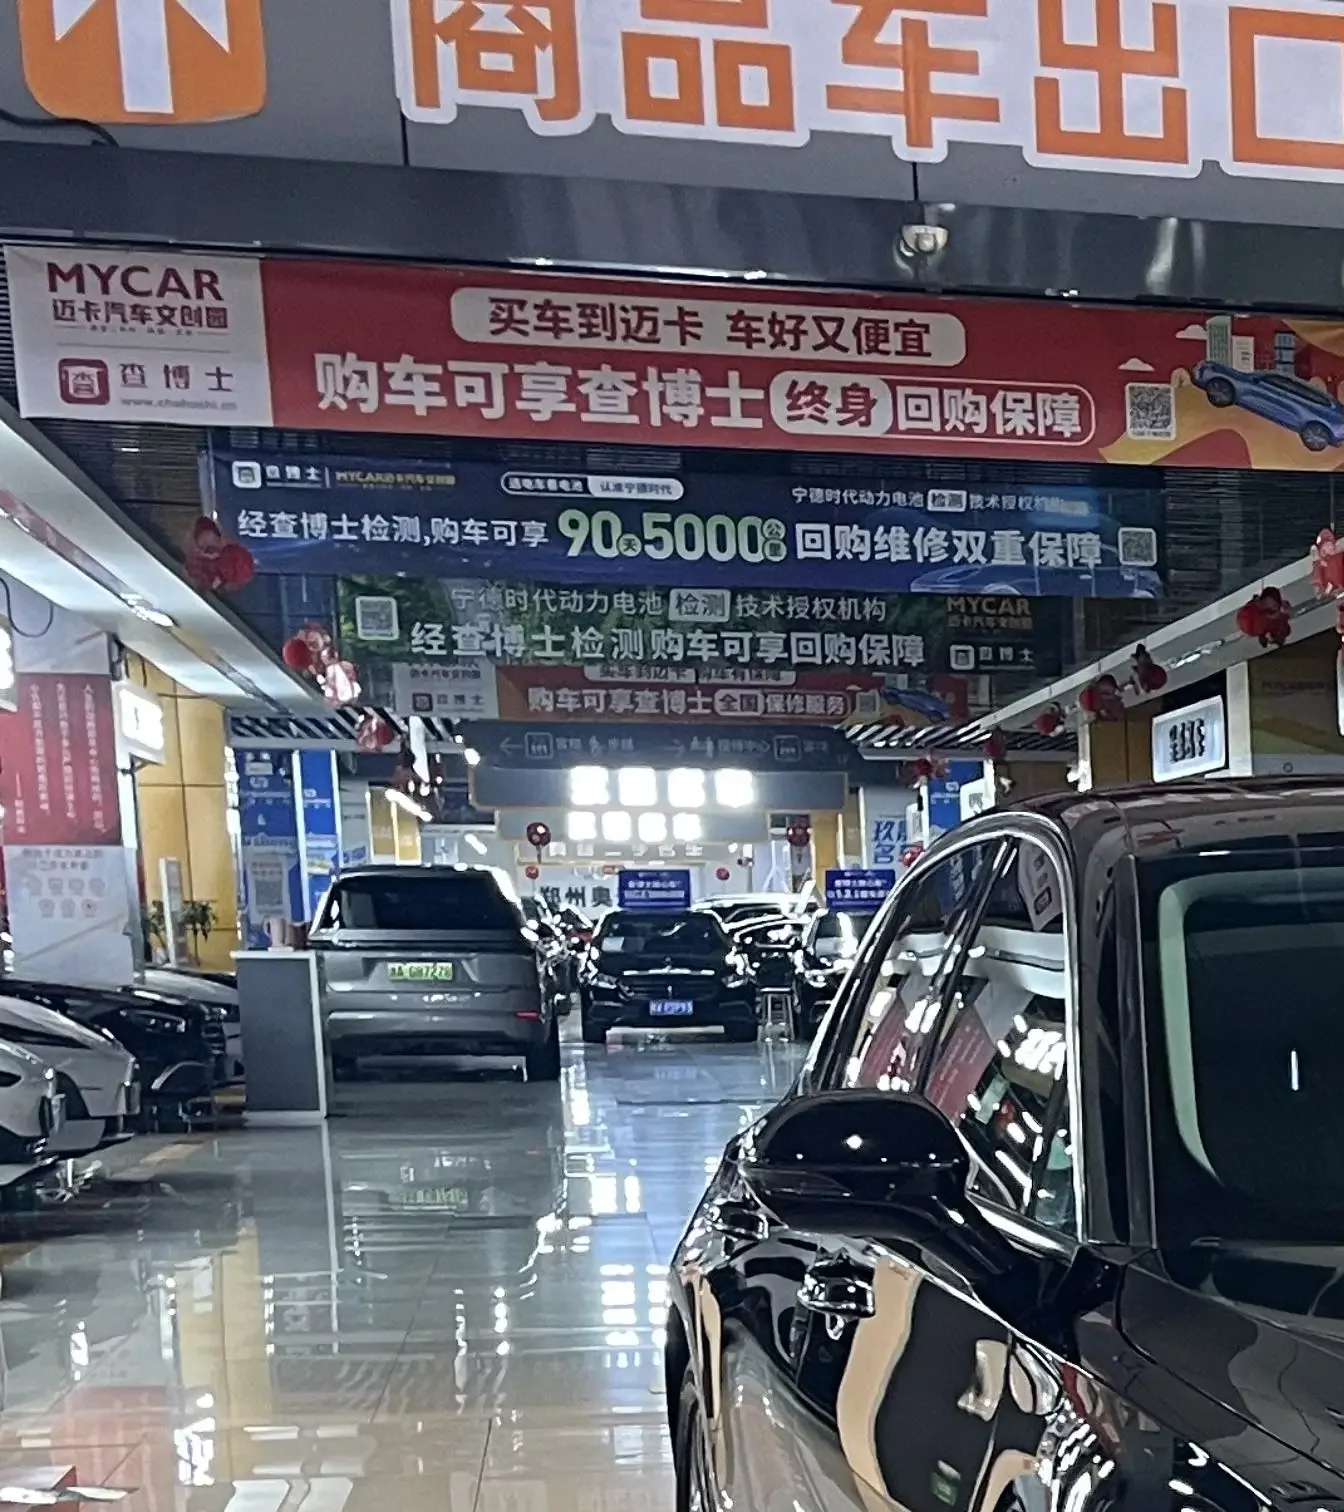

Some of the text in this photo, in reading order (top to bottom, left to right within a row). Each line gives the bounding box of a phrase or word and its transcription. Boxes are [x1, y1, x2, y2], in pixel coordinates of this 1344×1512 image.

[47, 262, 225, 301] MYCAR
[52, 299, 229, 329] 迈卡汽车文创园
[487, 296, 933, 359] 买车到迈卡 车好又便宜
[118, 362, 234, 393] 查博士
[315, 352, 1084, 441] 购车可享查博士终身回购保障
[794, 522, 1102, 568] 回购维修双重保障
[410, 621, 925, 668] 经查博士检测购车可享回购保障
